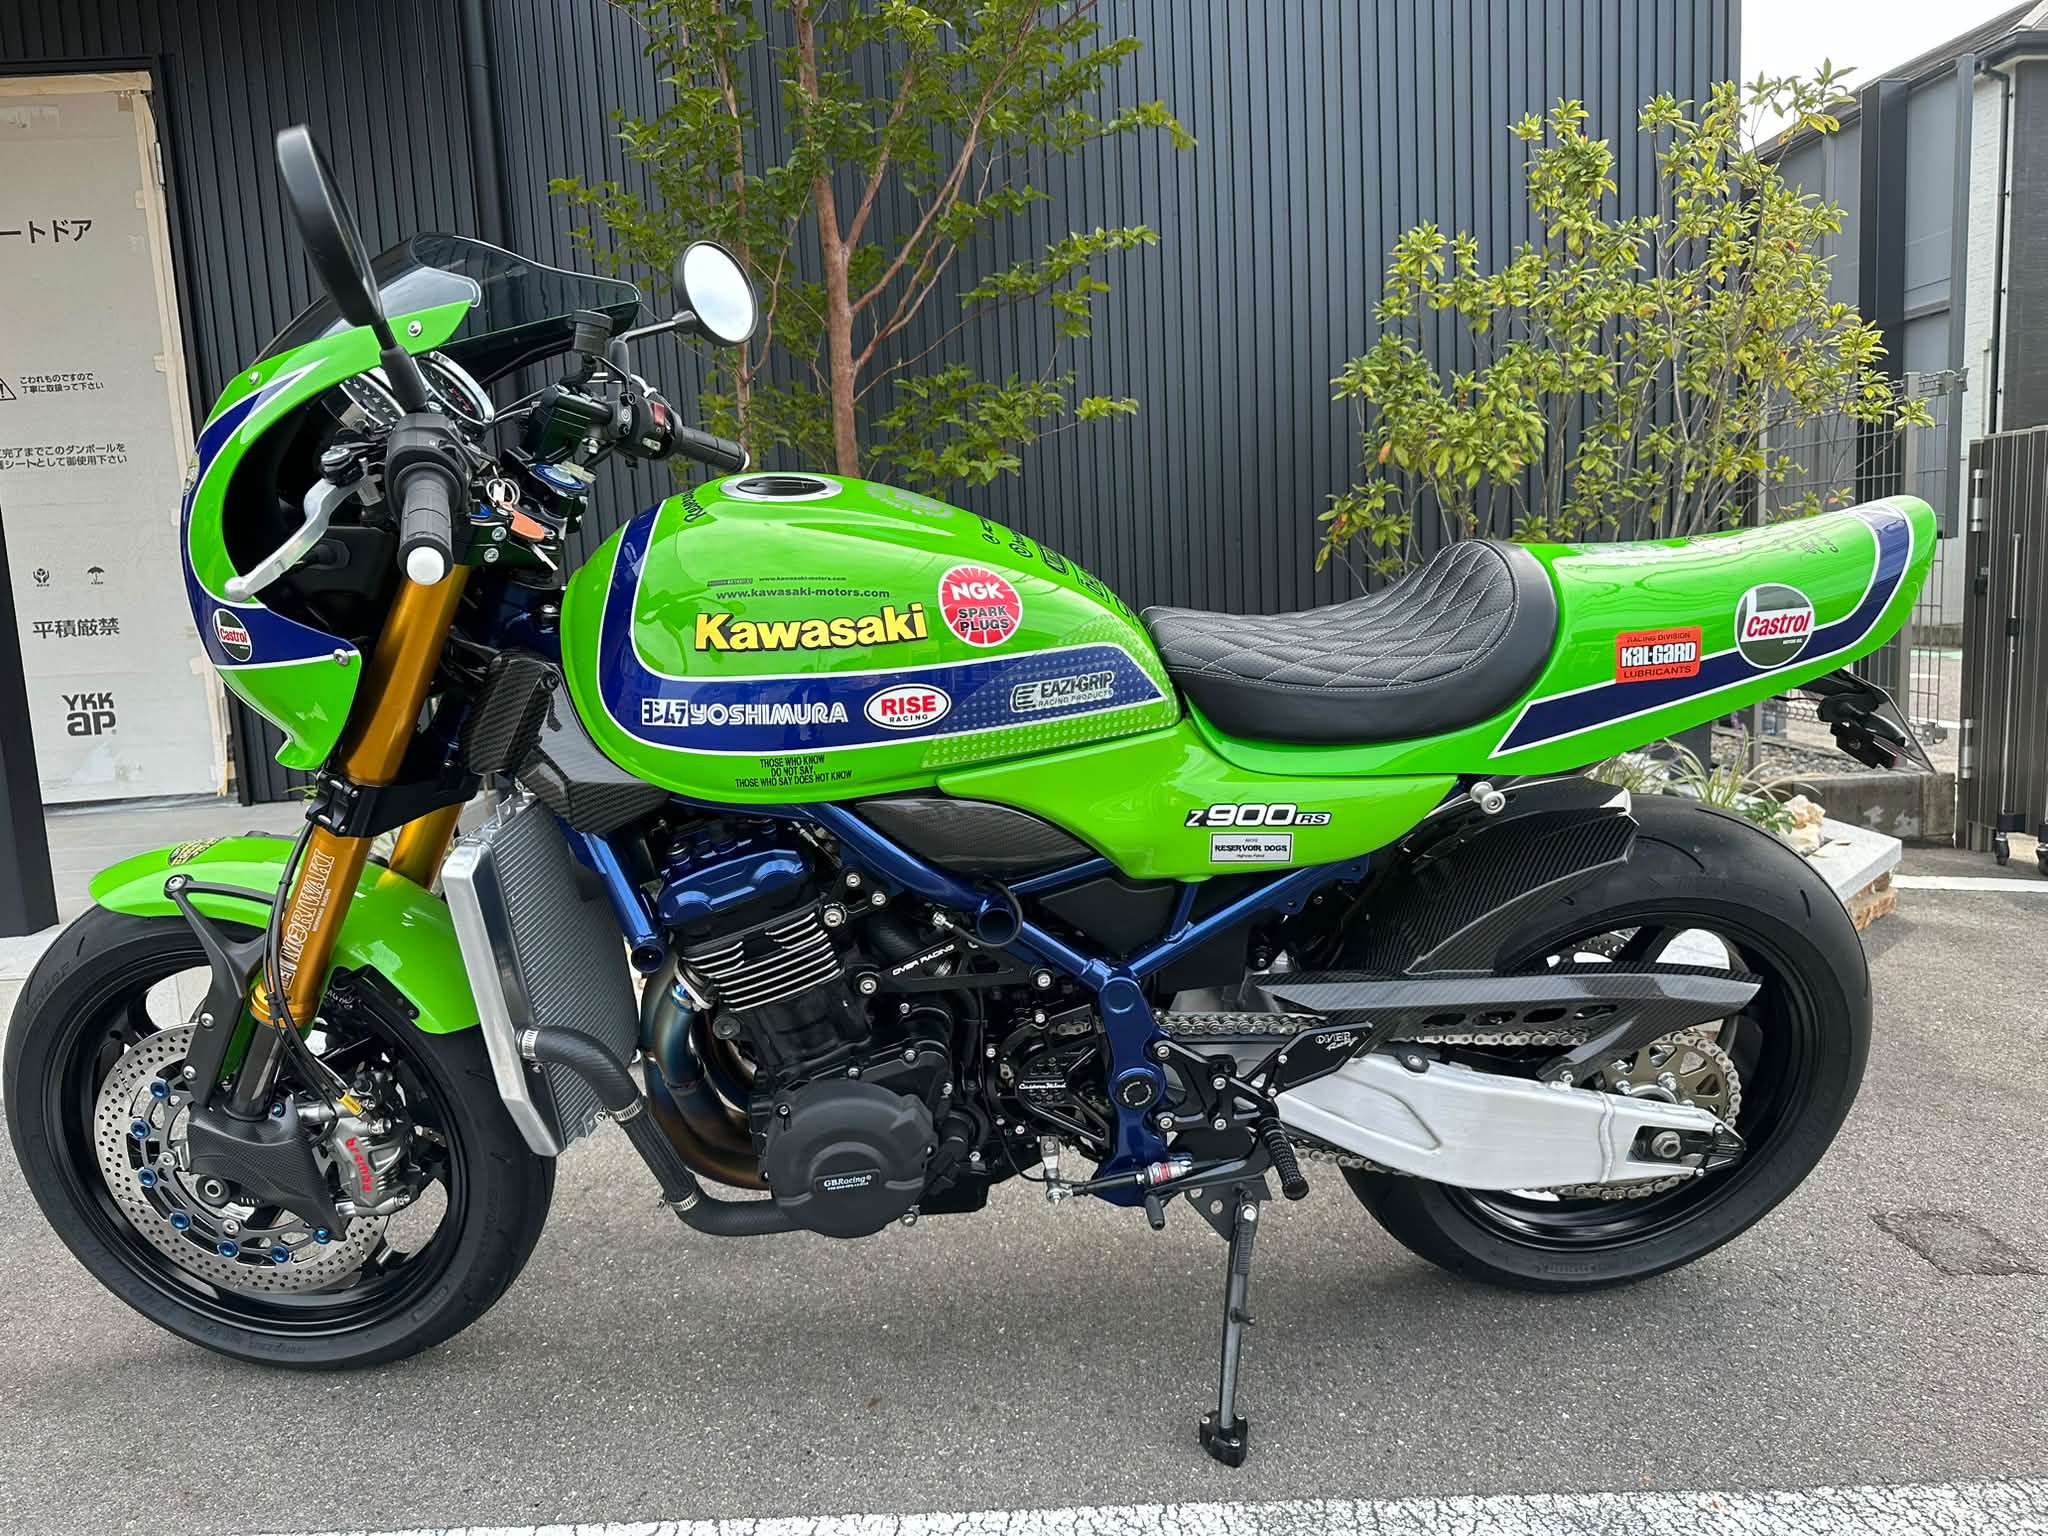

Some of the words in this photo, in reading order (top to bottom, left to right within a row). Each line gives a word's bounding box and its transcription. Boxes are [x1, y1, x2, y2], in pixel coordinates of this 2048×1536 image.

[716, 587, 890, 600] www.kawasaki-motors.com
[950, 582, 1004, 600] NGK
[958, 605, 1008, 619] SPARK
[32, 617, 120, 639] 平積厳禁
[695, 602, 928, 652] Kawasaki
[959, 617, 1010, 632] PLUGS
[1746, 611, 1811, 638] Castrol
[220, 627, 248, 643] Castrol
[1657, 632, 1690, 641] DIVISION
[1623, 665, 1692, 678] LUBRICANTS
[61, 692, 115, 711] YKK
[880, 694, 937, 716] RISE
[66, 710, 117, 737] ap
[690, 702, 849, 727] YOSHIMURA
[889, 713, 928, 723] RACING
[760, 758, 784, 768] THOSE
[785, 756, 802, 767] WHO
[803, 754, 825, 765] KNOW
[735, 778, 759, 787] THOSE
[761, 777, 777, 787] WHO
[778, 776, 793, 786] SAY
[794, 774, 814, 785] DOES
[830, 769, 852, 781] KNOW
[771, 767, 782, 777] DO
[784, 766, 798, 776] NOT
[1214, 844, 1262, 852] RESERVOIR
[1264, 844, 1288, 852] DOGS
[280, 848, 335, 962] MORIWAKI
[892, 959, 920, 976] OVER
[920, 944, 955, 964] RACING
[345, 1135, 374, 1194] brembo
